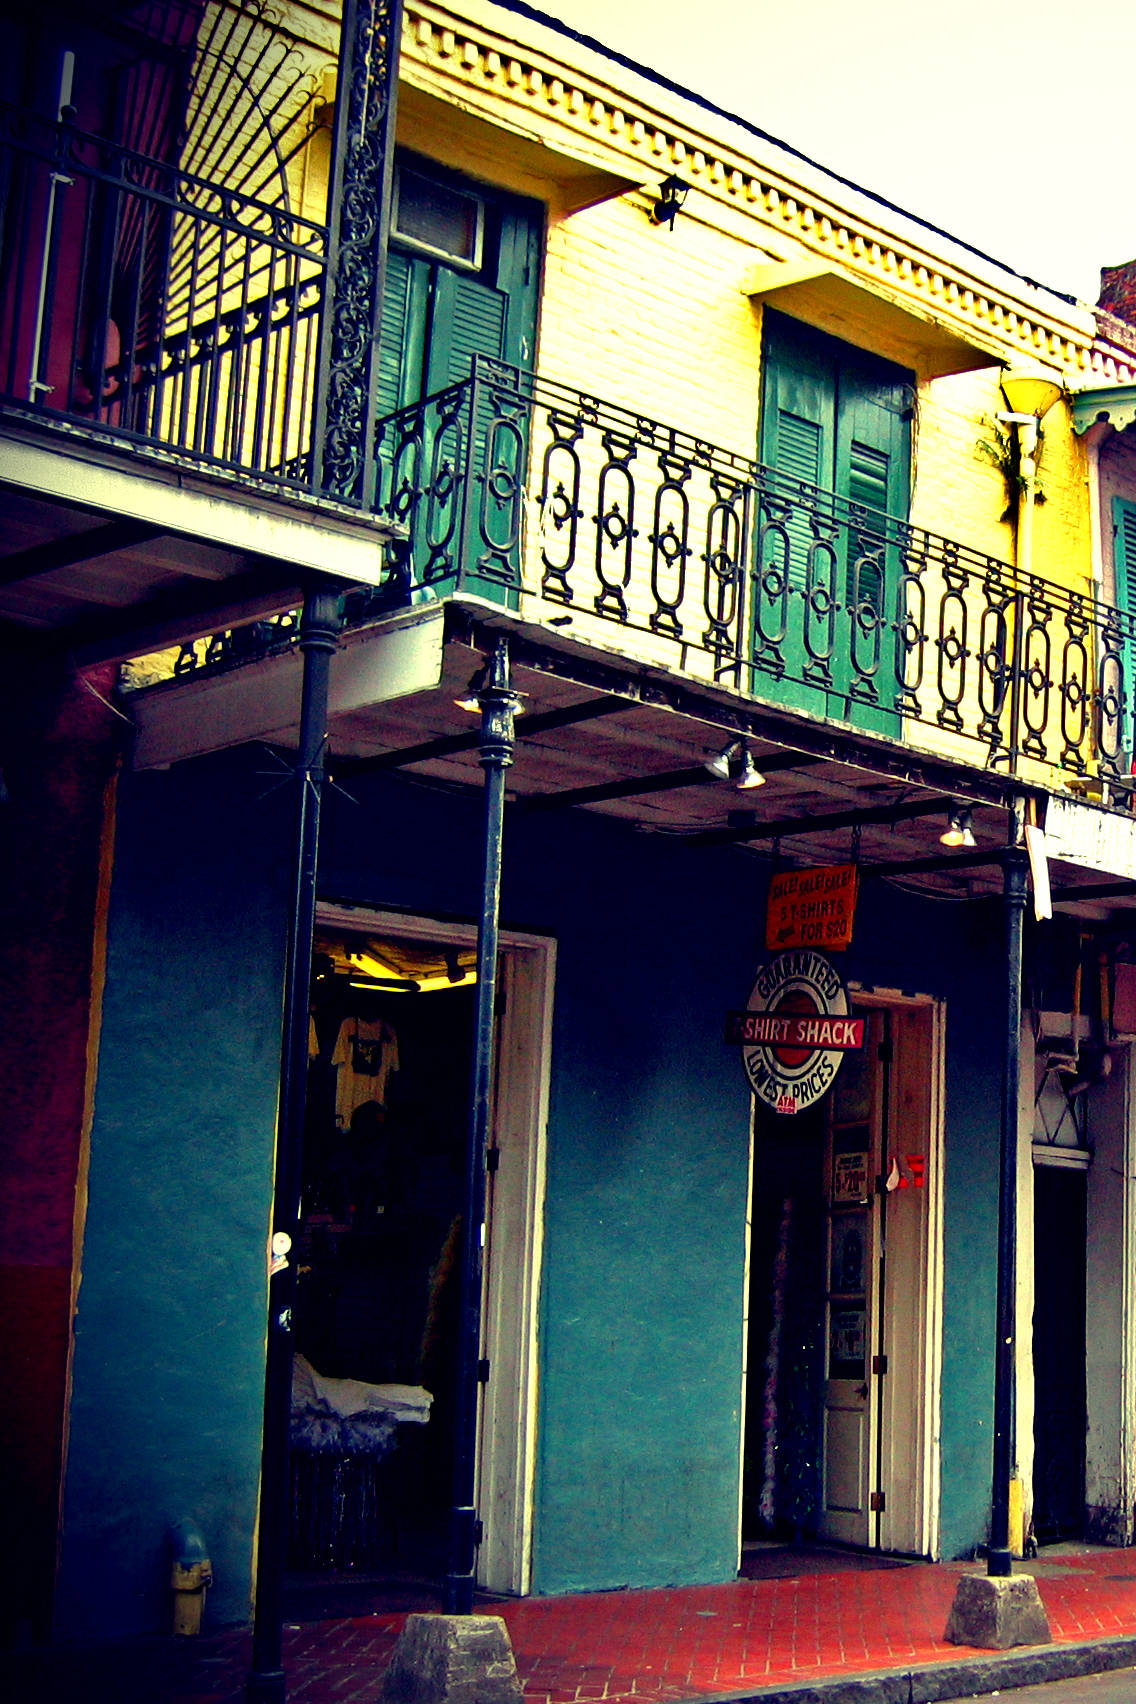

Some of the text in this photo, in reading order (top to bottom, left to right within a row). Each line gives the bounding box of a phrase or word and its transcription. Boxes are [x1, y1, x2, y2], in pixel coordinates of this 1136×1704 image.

[824, 869, 852, 893] SALE!
[800, 921, 823, 940] FOR
[757, 952, 841, 1000] GUARANTEED
[797, 1020, 857, 1045] SHACK
[746, 1050, 834, 1103] LOWEST PRICES
[777, 1095, 796, 1108] ATM
